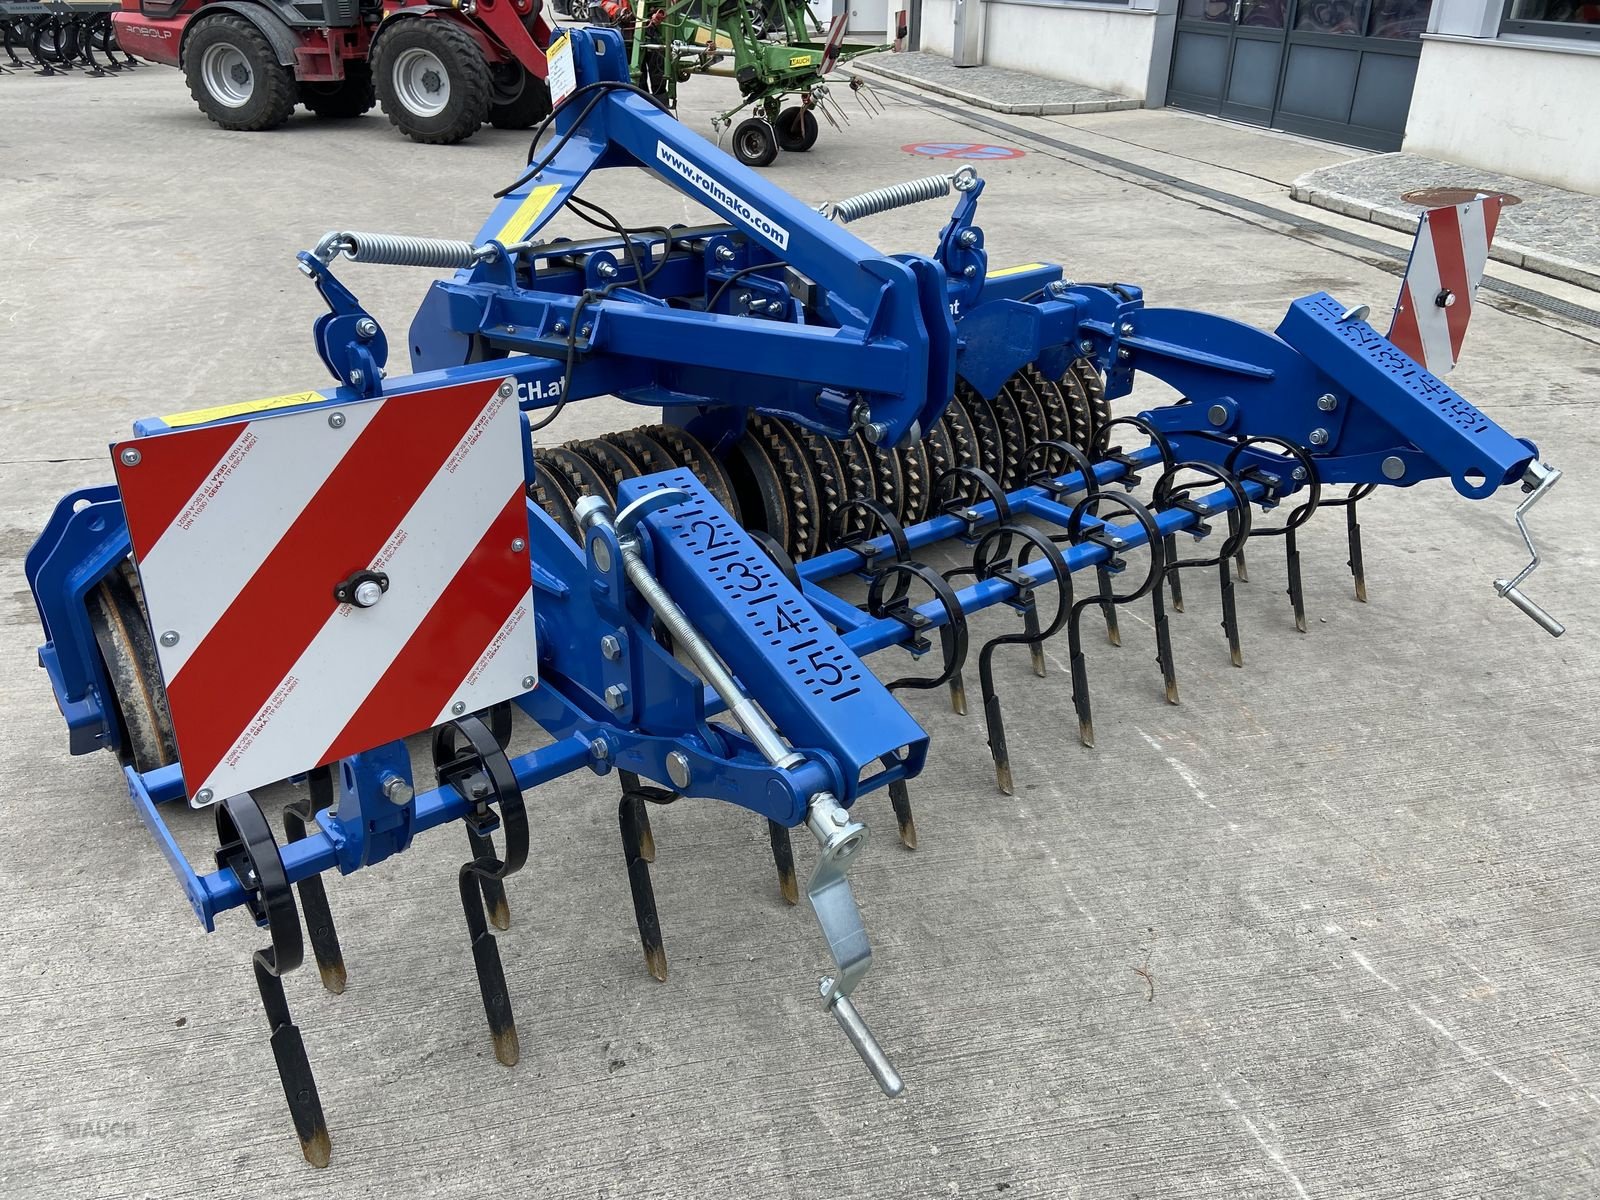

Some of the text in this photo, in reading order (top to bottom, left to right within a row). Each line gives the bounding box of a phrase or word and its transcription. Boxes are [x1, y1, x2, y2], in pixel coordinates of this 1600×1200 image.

[661, 147, 785, 245] www.rolmako.com
[1347, 325, 1372, 344] 2
[1380, 351, 1404, 369] 3
[1418, 377, 1441, 395] 4
[1451, 405, 1475, 424] 5
[242, 432, 252, 444] DIN
[229, 444, 243, 461] 11030
[212, 464, 228, 482] GEKA
[183, 518, 194, 530] DIN
[192, 501, 207, 518] 11030
[208, 480, 224, 498] GEKA
[225, 468, 233, 477] TP
[231, 450, 247, 469] ESC-A
[244, 436, 259, 452] 06021
[203, 484, 212, 494] TP
[189, 493, 205, 511] ESC-A
[177, 510, 191, 527] 06021
[691, 521, 728, 550] 2
[727, 562, 762, 591] 3
[776, 604, 803, 634] 4
[808, 651, 843, 685] 5
